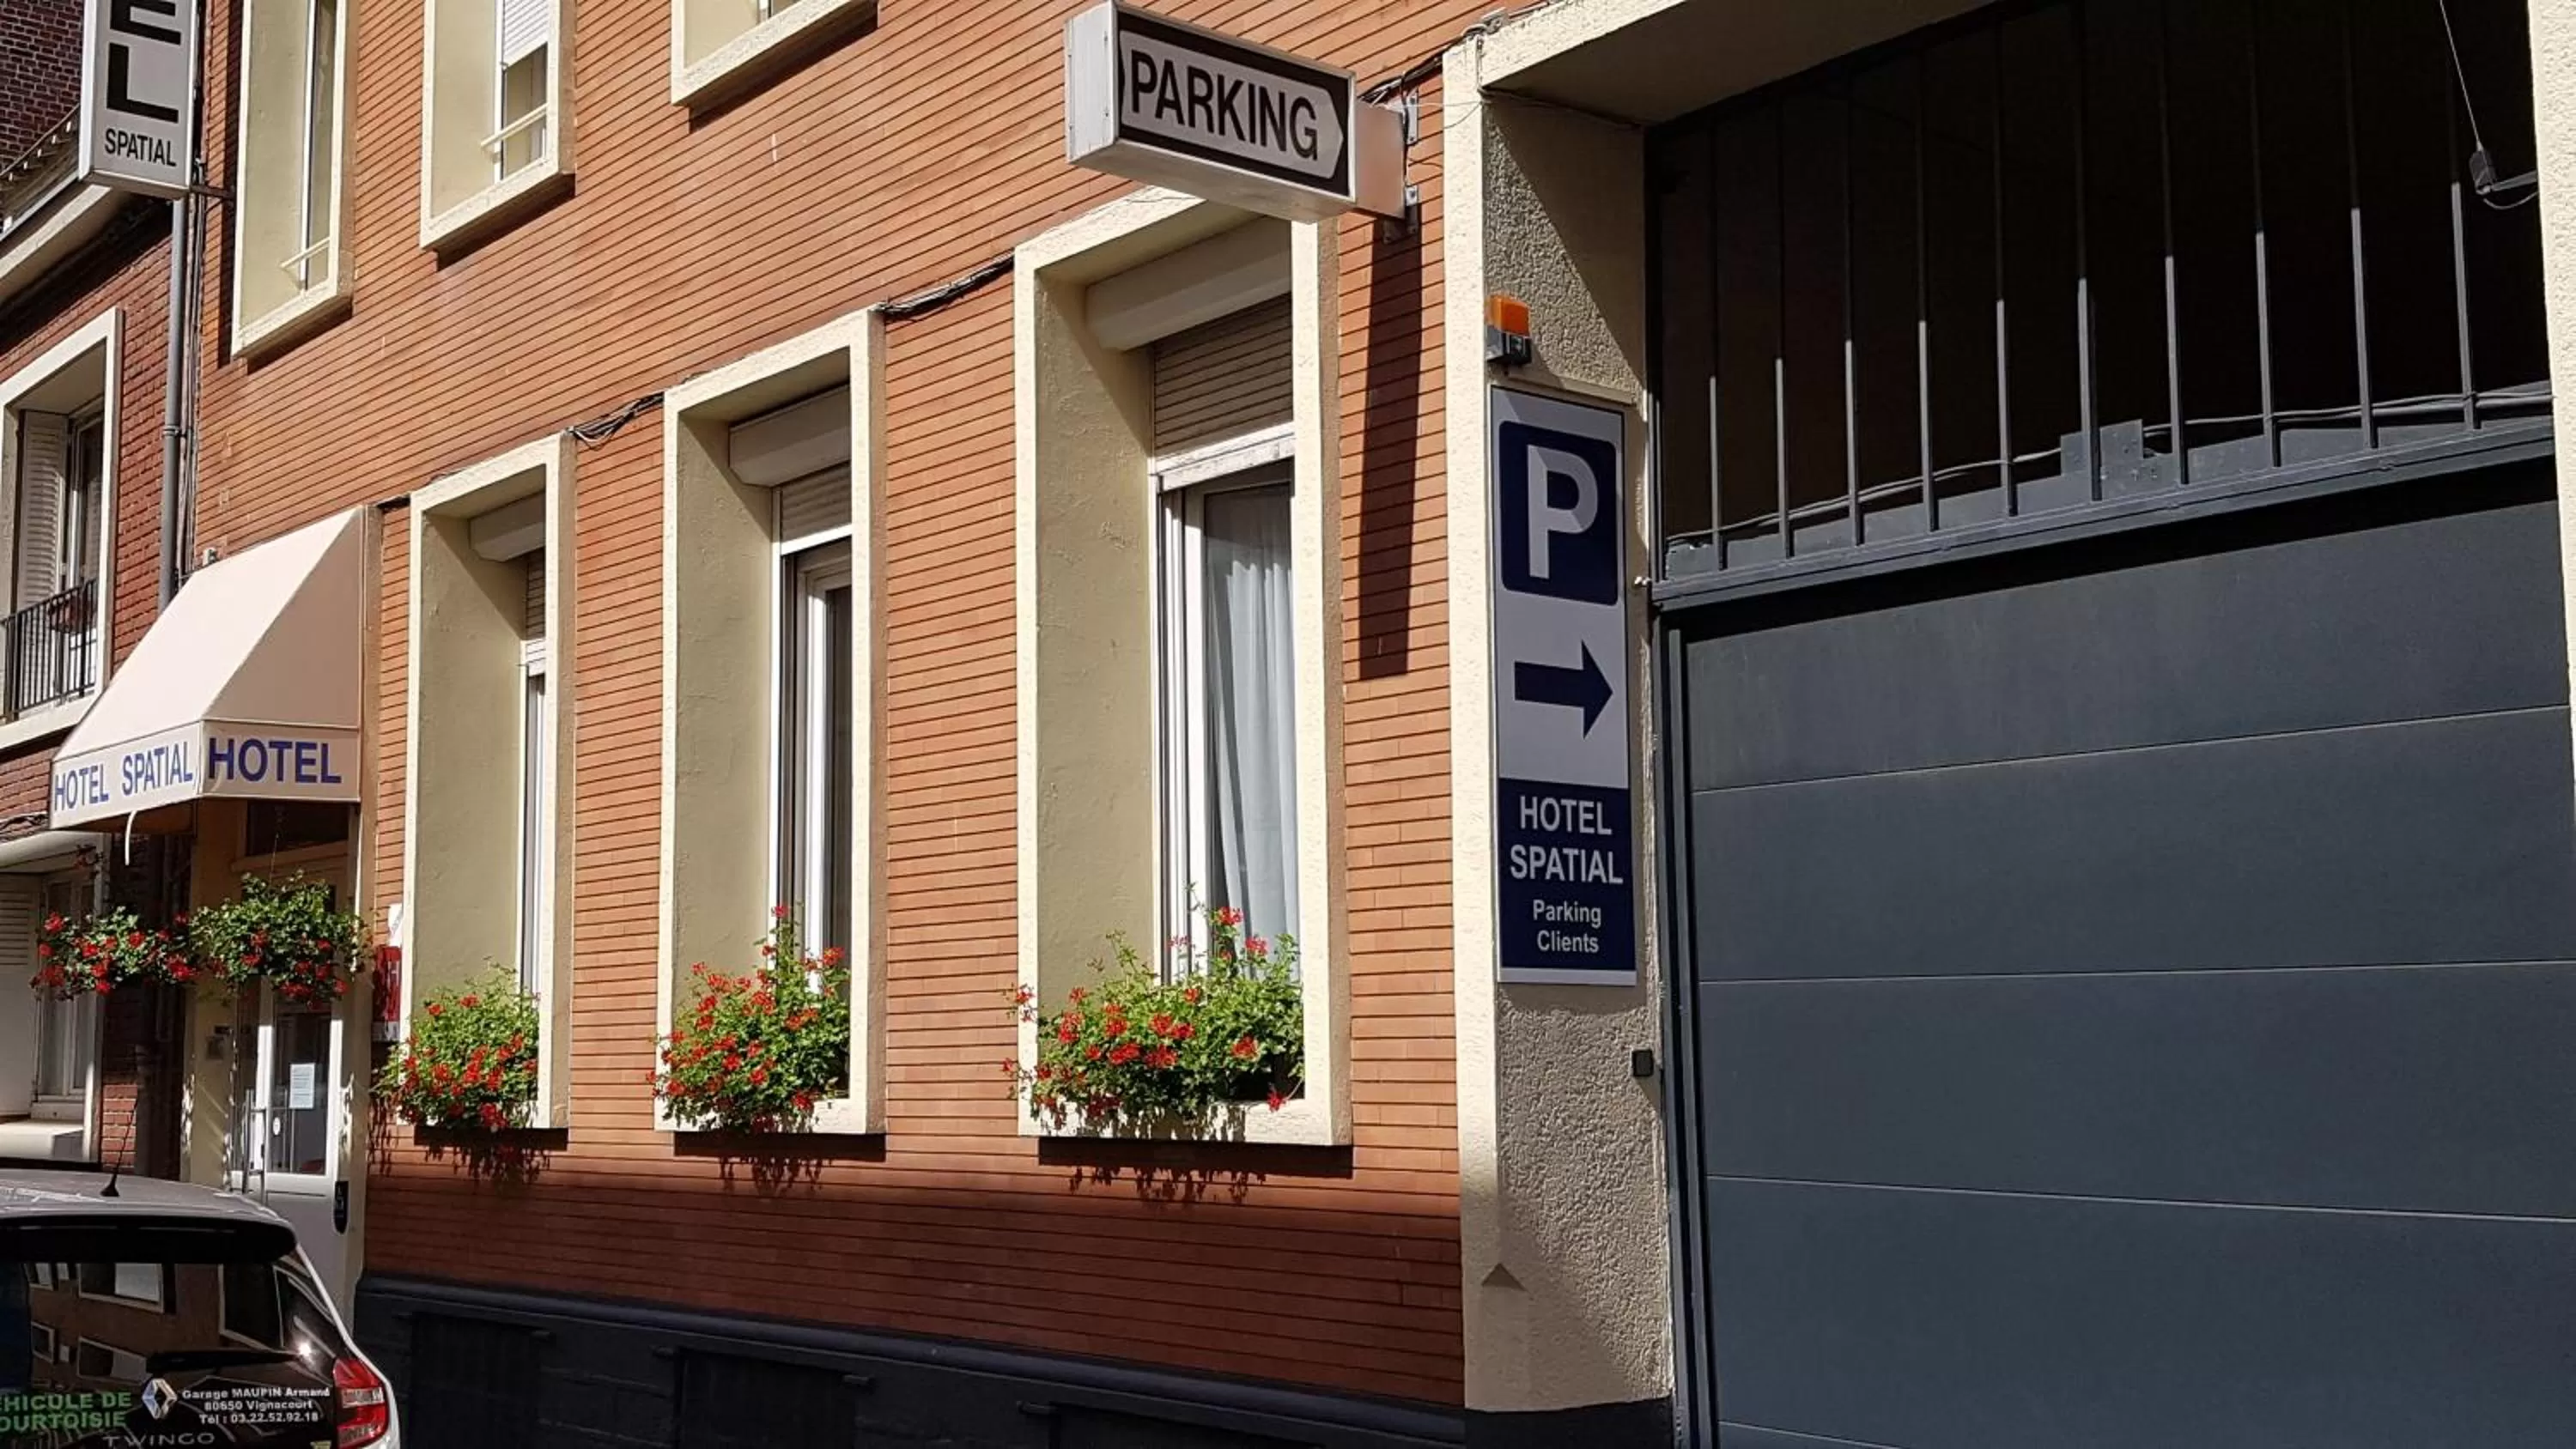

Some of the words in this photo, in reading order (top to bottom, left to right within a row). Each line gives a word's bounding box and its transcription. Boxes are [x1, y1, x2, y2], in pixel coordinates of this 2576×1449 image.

[1130, 49, 1318, 161] PARKING
[104, 128, 177, 167] SPATIAL
[1527, 443, 1599, 580] P
[54, 764, 109, 811] HOTEL
[122, 741, 193, 796] SPATIAL
[209, 737, 342, 784] HOTEL
[1520, 796, 1612, 835] HOTEL
[1510, 844, 1624, 884] SPATIAL
[1533, 900, 1601, 929] Parking
[1537, 930, 1599, 953] Clients
[0, 1393, 94, 1412] HICULE
[101, 1391, 132, 1409] DE
[181, 1389, 229, 1400] Garage
[232, 1387, 282, 1398] MAUPIN
[284, 1387, 331, 1397] Armand
[245, 1400, 313, 1412] Vignacourt
[101, 1432, 215, 1448] TWINGO
